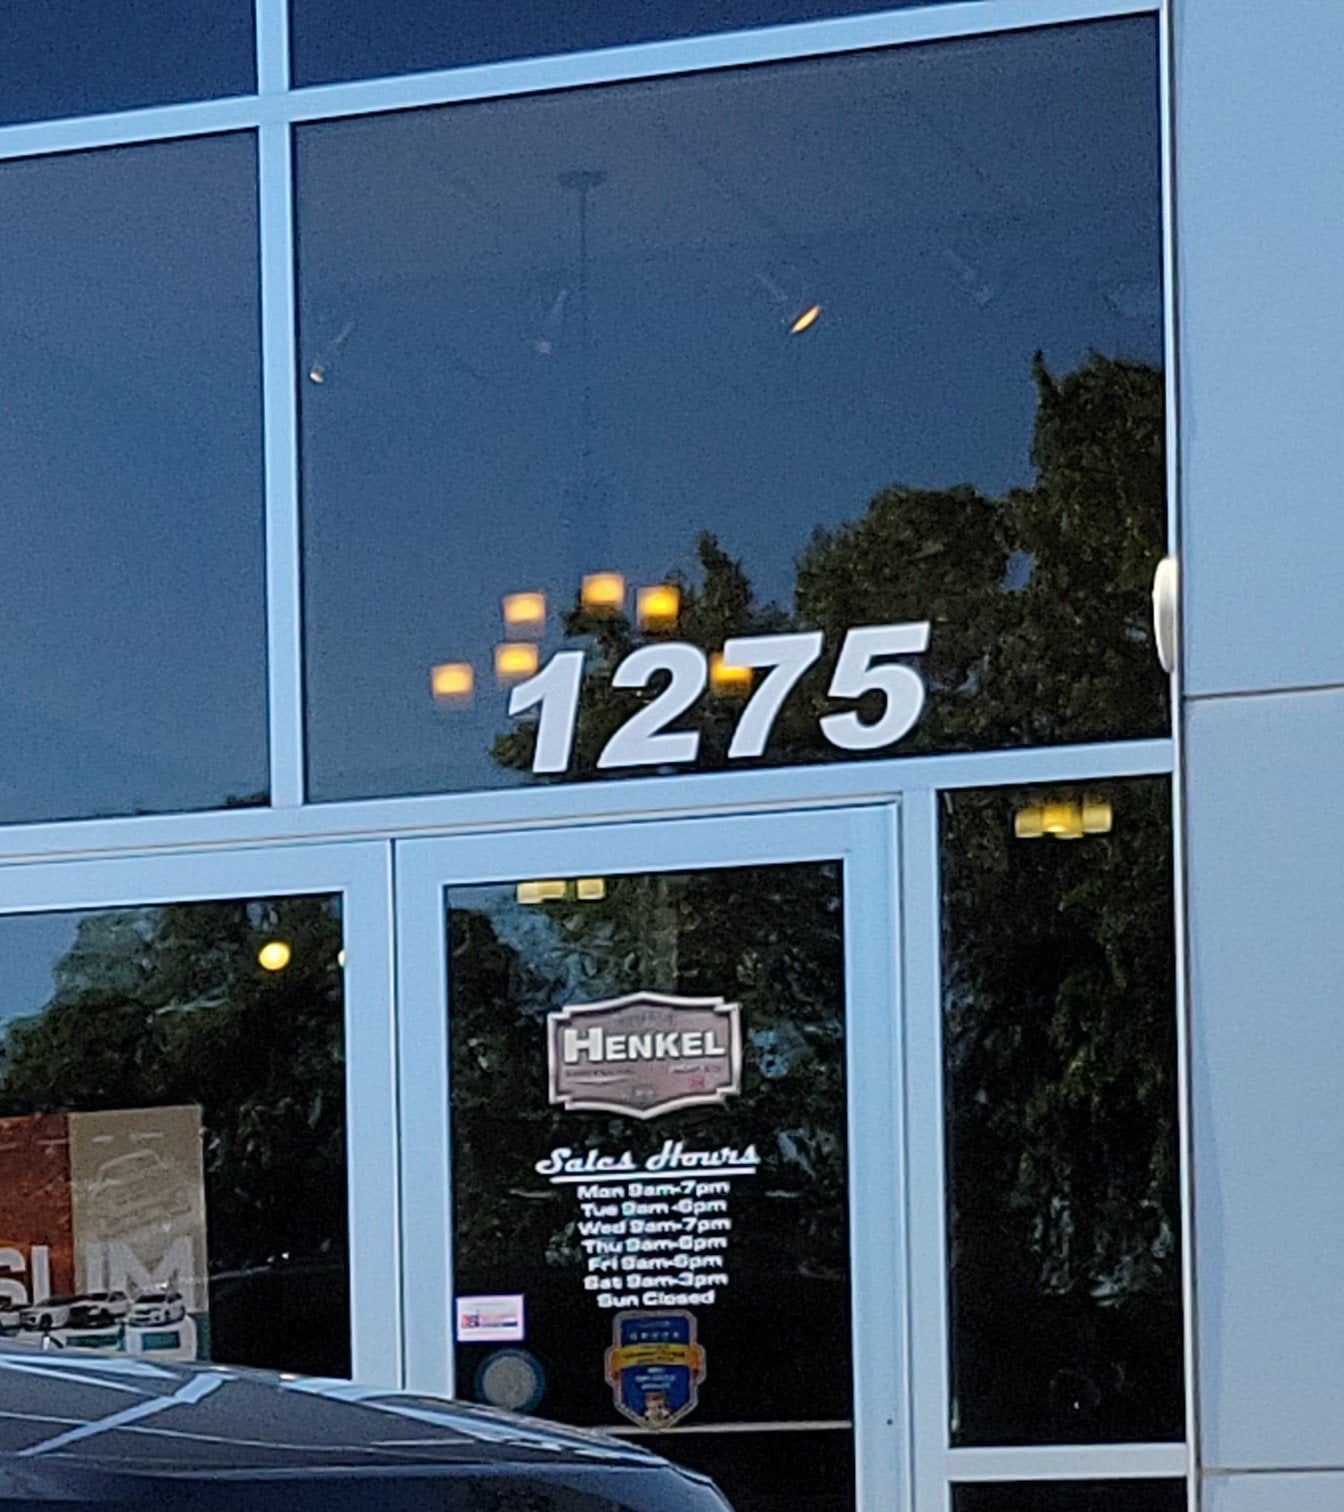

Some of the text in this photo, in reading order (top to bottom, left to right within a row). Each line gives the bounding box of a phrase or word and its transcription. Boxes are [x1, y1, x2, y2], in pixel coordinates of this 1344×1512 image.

[508, 621, 930, 773] 1275
[564, 1027, 726, 1063] HENKEL
[535, 1139, 761, 1175] Sales Hours
[577, 1184, 625, 1199] Mon
[580, 1202, 619, 1217] Tue
[577, 1220, 627, 1236] Wed
[580, 1238, 623, 1254] Thu
[588, 1256, 618, 1272] Fri
[583, 1275, 623, 1290] Sat
[596, 1289, 716, 1308] Sun Closed
